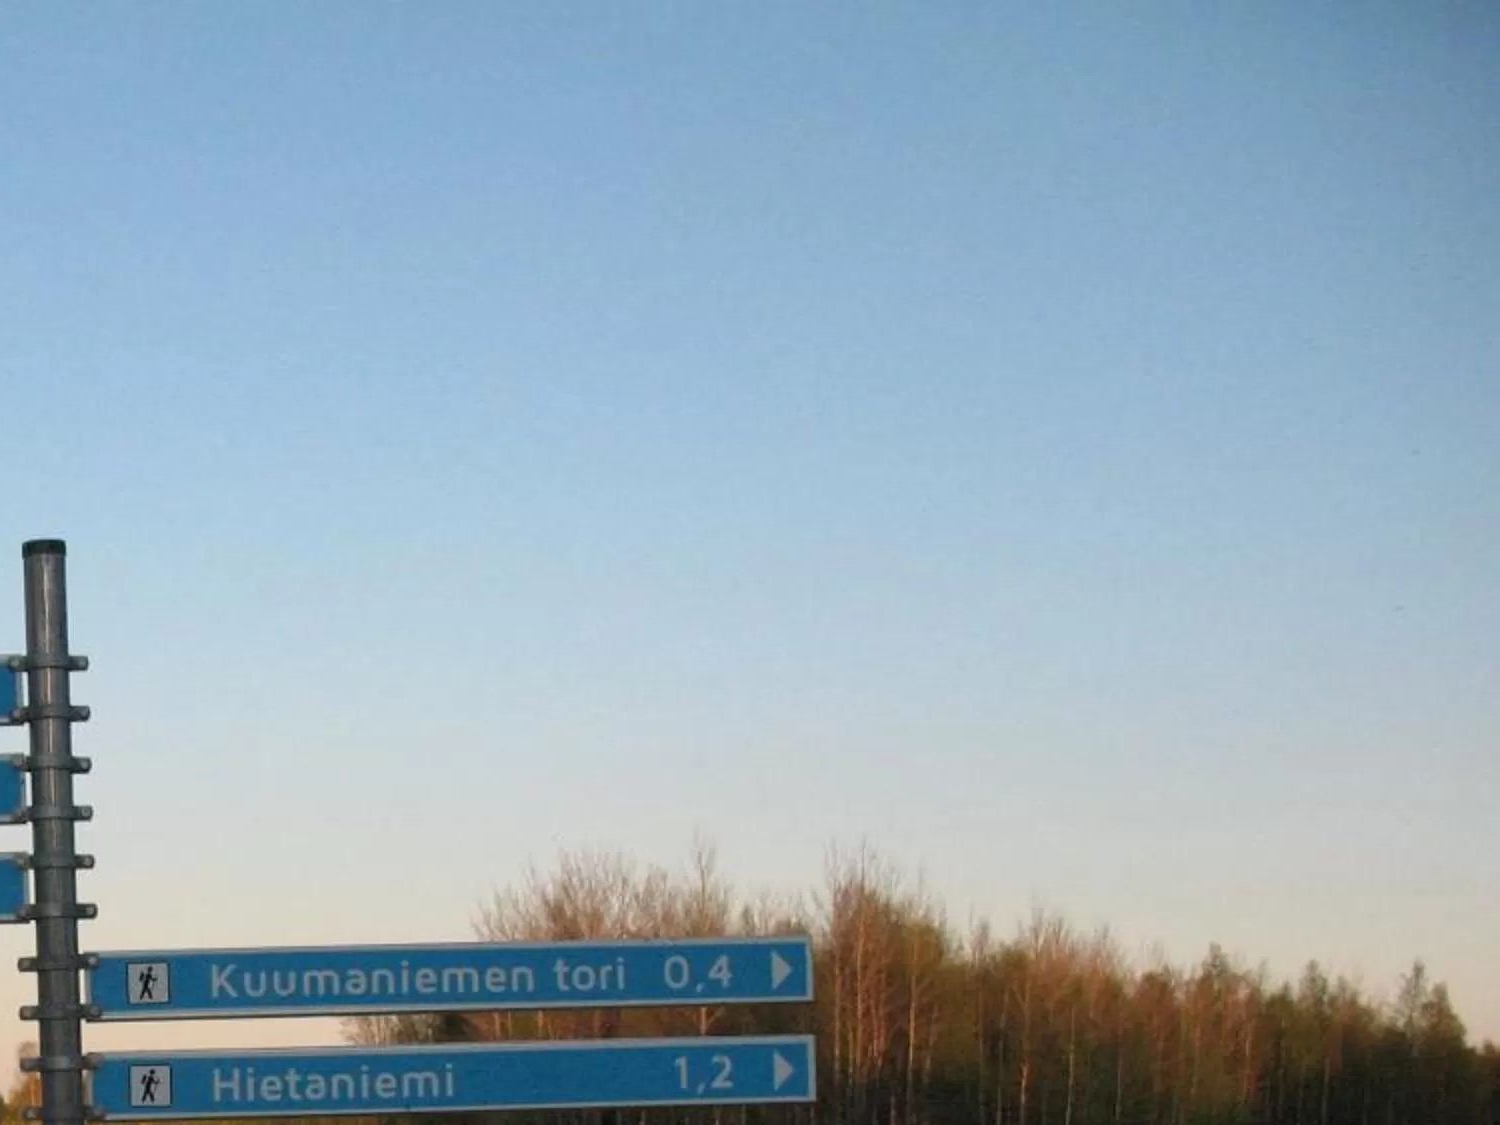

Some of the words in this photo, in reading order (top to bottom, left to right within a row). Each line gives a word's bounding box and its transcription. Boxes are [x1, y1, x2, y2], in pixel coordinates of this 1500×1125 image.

[211, 960, 535, 998] Kuumaniemen
[553, 957, 626, 991] tori
[663, 955, 733, 993] 0,4
[211, 1063, 455, 1102] Hietaniemi
[674, 1055, 734, 1094] 1,2
